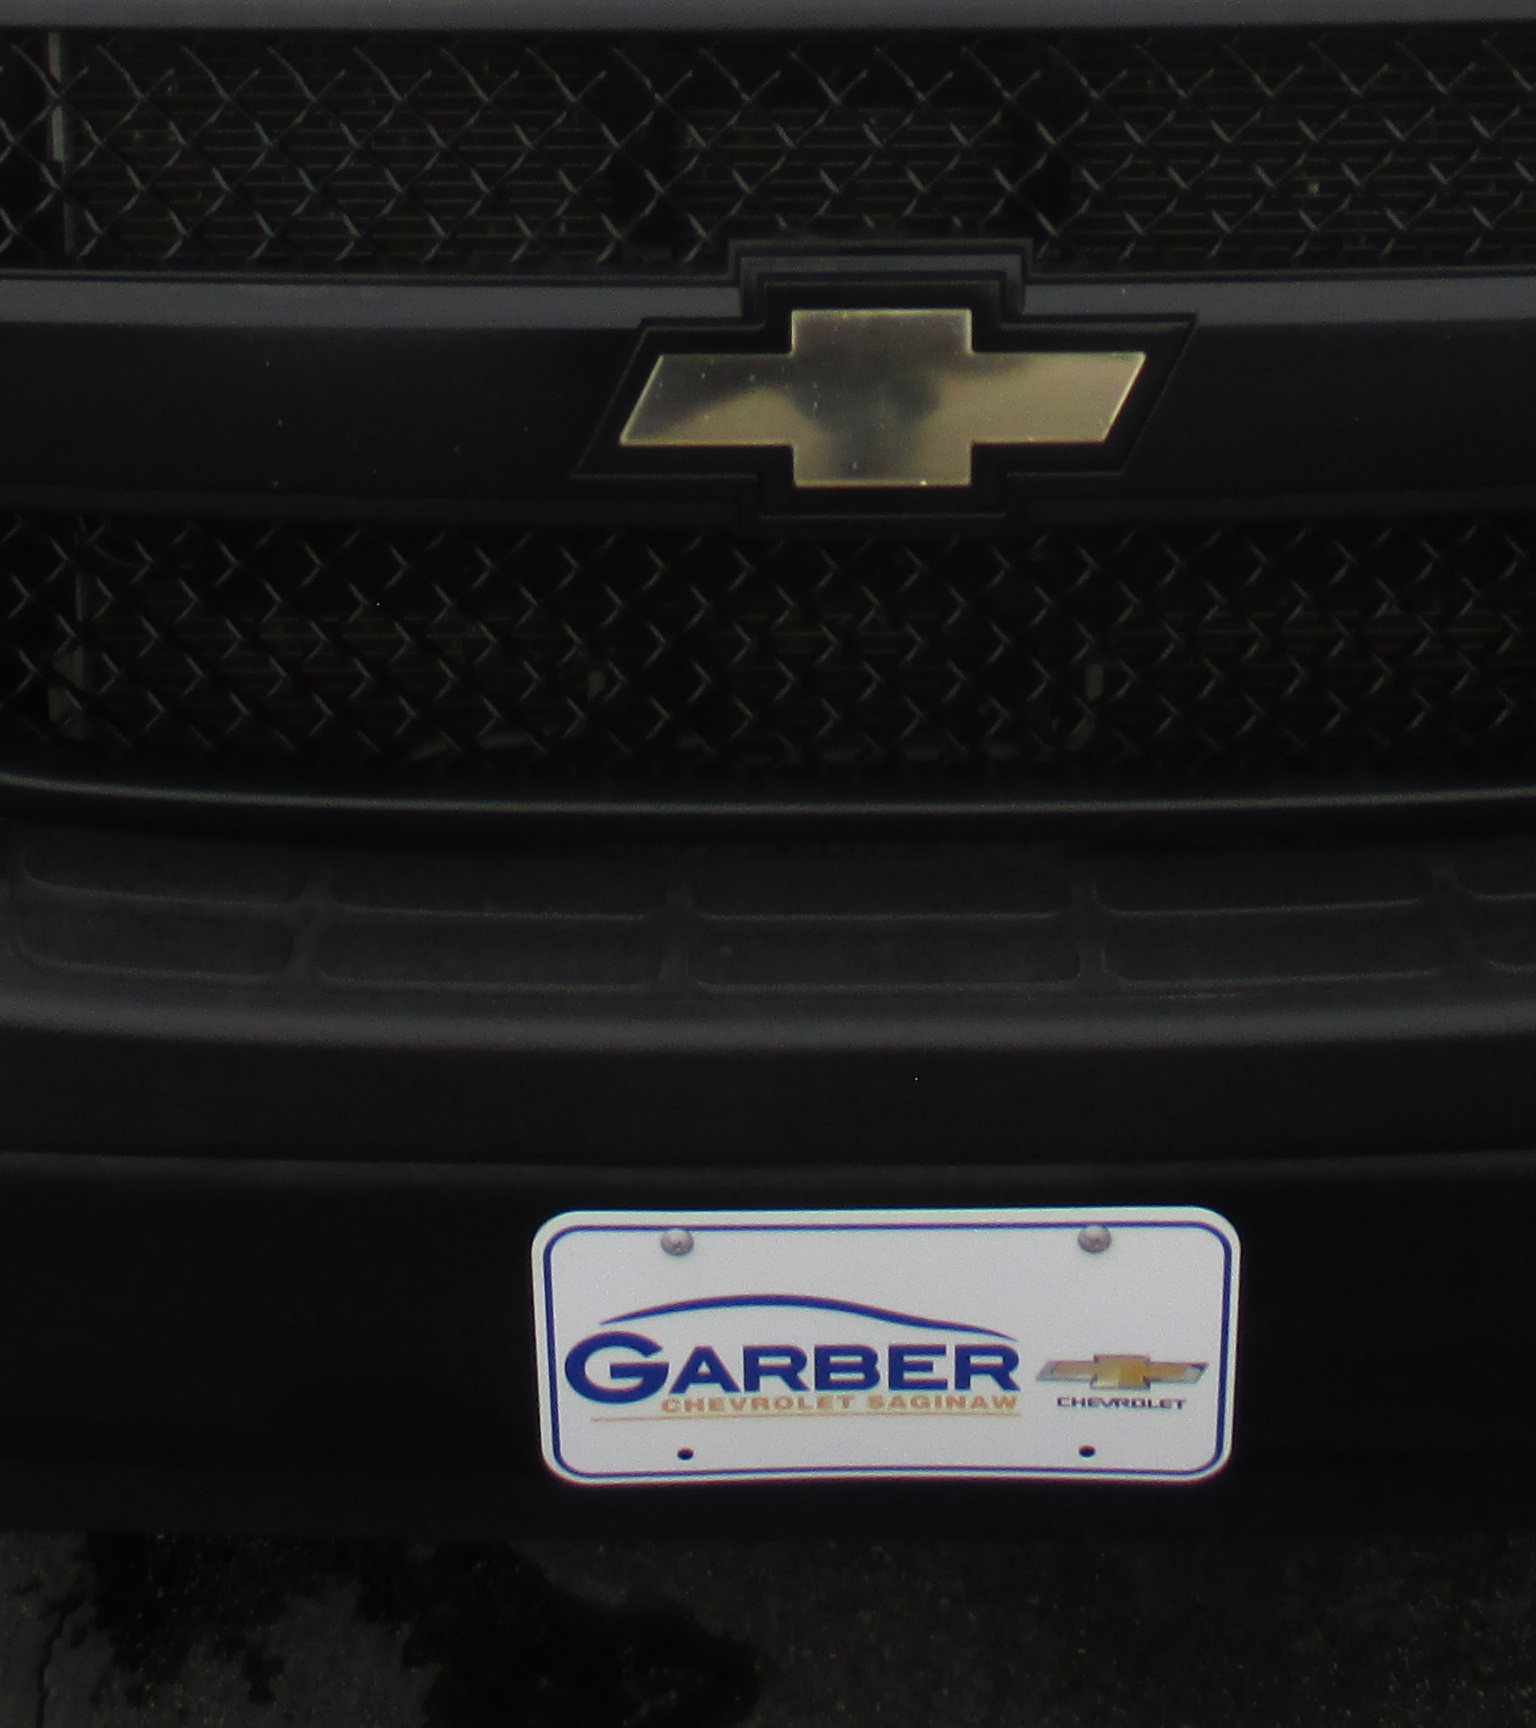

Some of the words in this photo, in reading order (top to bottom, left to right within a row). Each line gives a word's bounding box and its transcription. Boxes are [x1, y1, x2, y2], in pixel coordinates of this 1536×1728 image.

[565, 1331, 1021, 1404] GARBER
[662, 1395, 854, 1413] CHEVROLET
[868, 1394, 1018, 1410] SAGINAW
[1057, 1397, 1187, 1409] CHEVROLET
